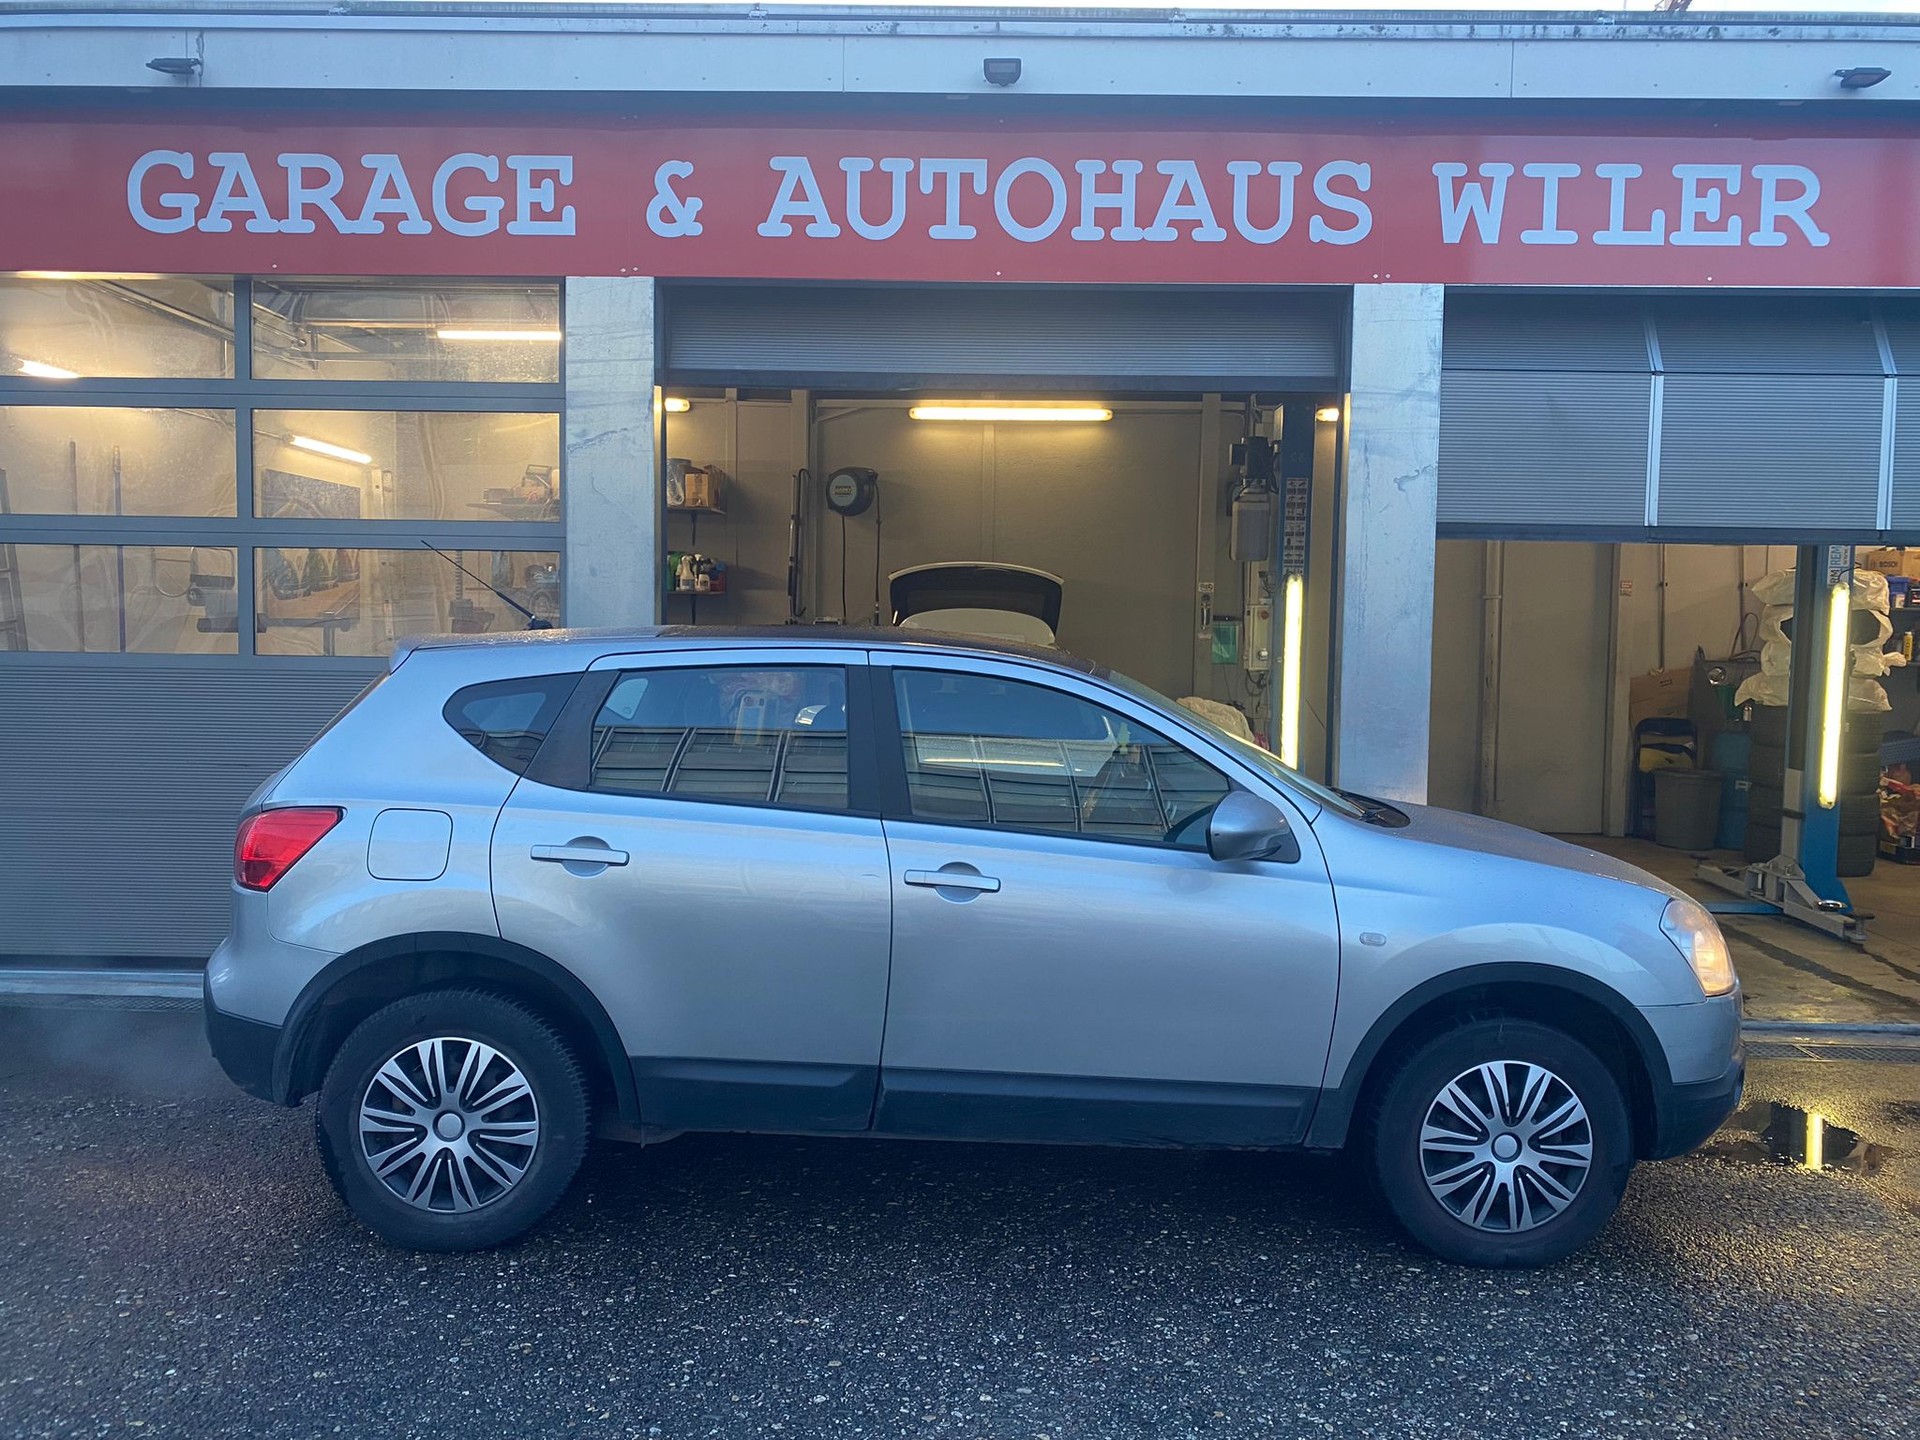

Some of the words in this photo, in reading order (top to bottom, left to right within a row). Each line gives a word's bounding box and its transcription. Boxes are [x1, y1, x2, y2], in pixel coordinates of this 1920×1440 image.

[127, 150, 576, 236] GARAGE
[646, 160, 703, 237] &
[757, 156, 1374, 245] AUTOHAUS
[1432, 162, 1831, 247] WILER
